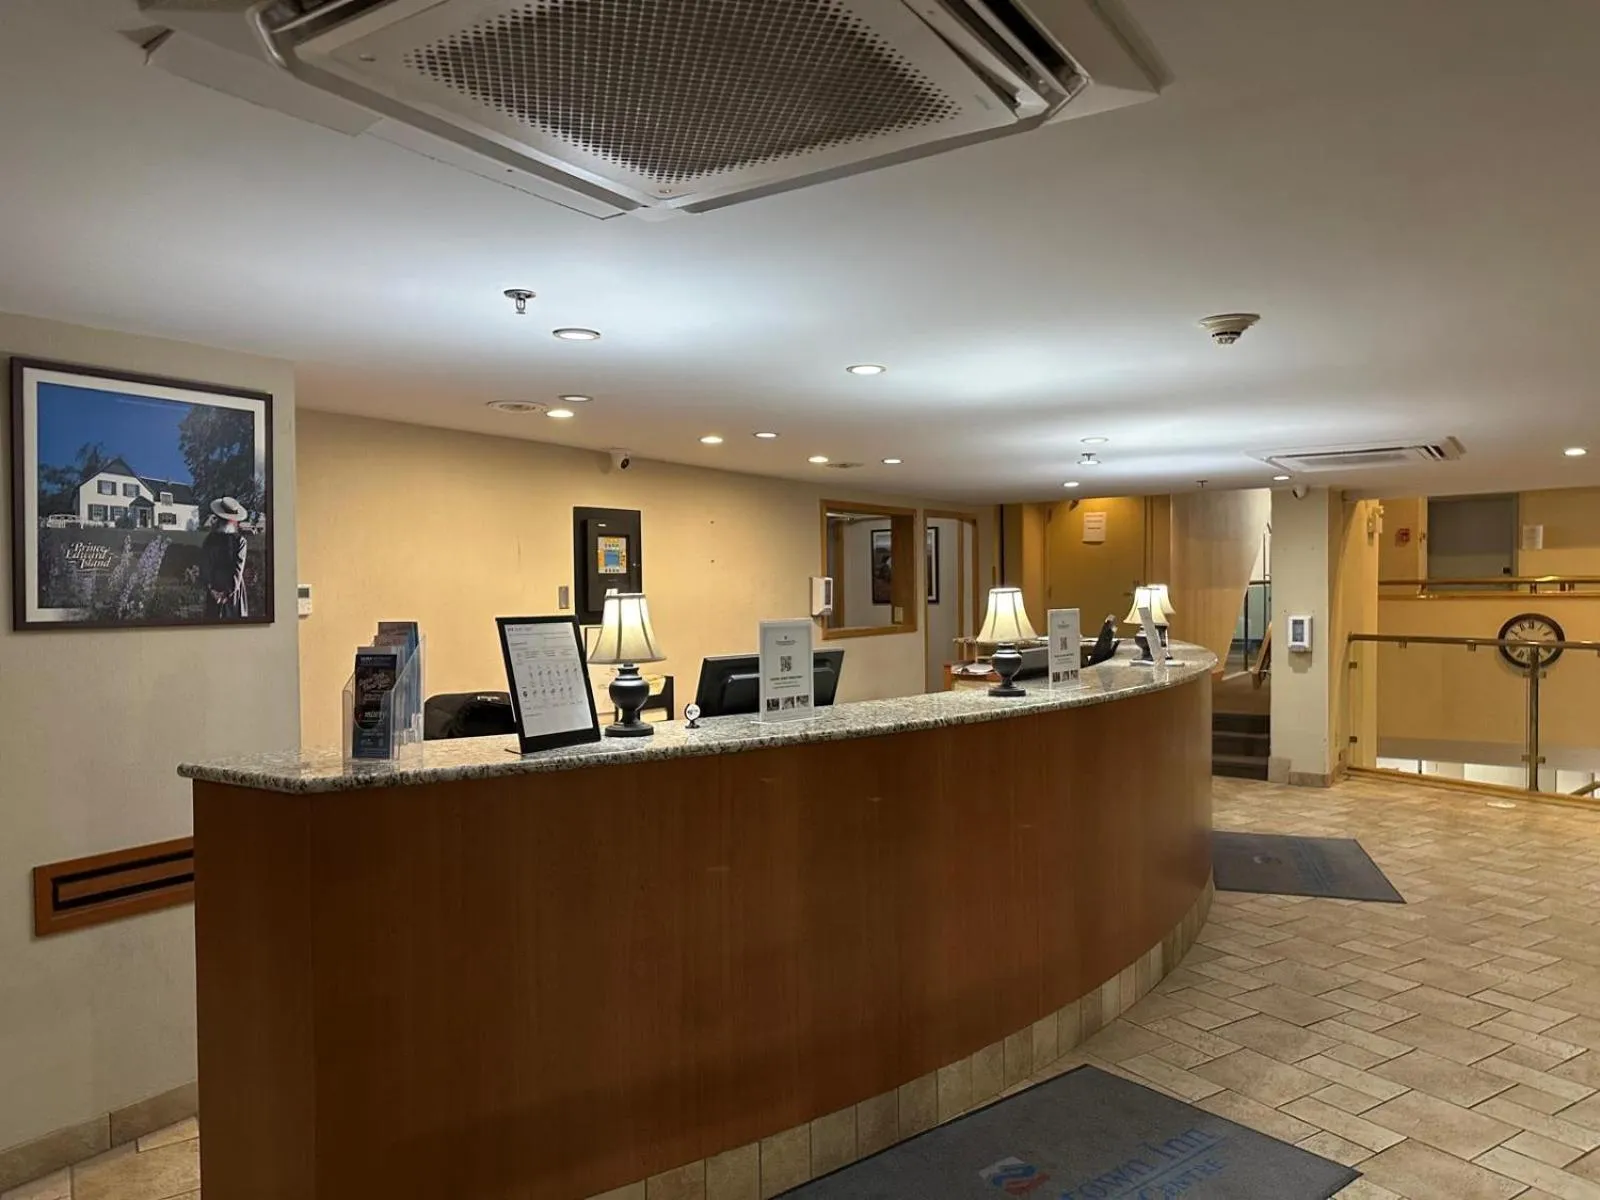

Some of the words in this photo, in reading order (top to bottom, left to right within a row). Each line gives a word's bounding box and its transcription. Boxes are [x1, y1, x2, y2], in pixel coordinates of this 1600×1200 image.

[70, 541, 111, 553] Prince
[65, 549, 110, 560] Edward
[80, 556, 112, 569] Island
[1136, 1127, 1216, 1160] Inn
